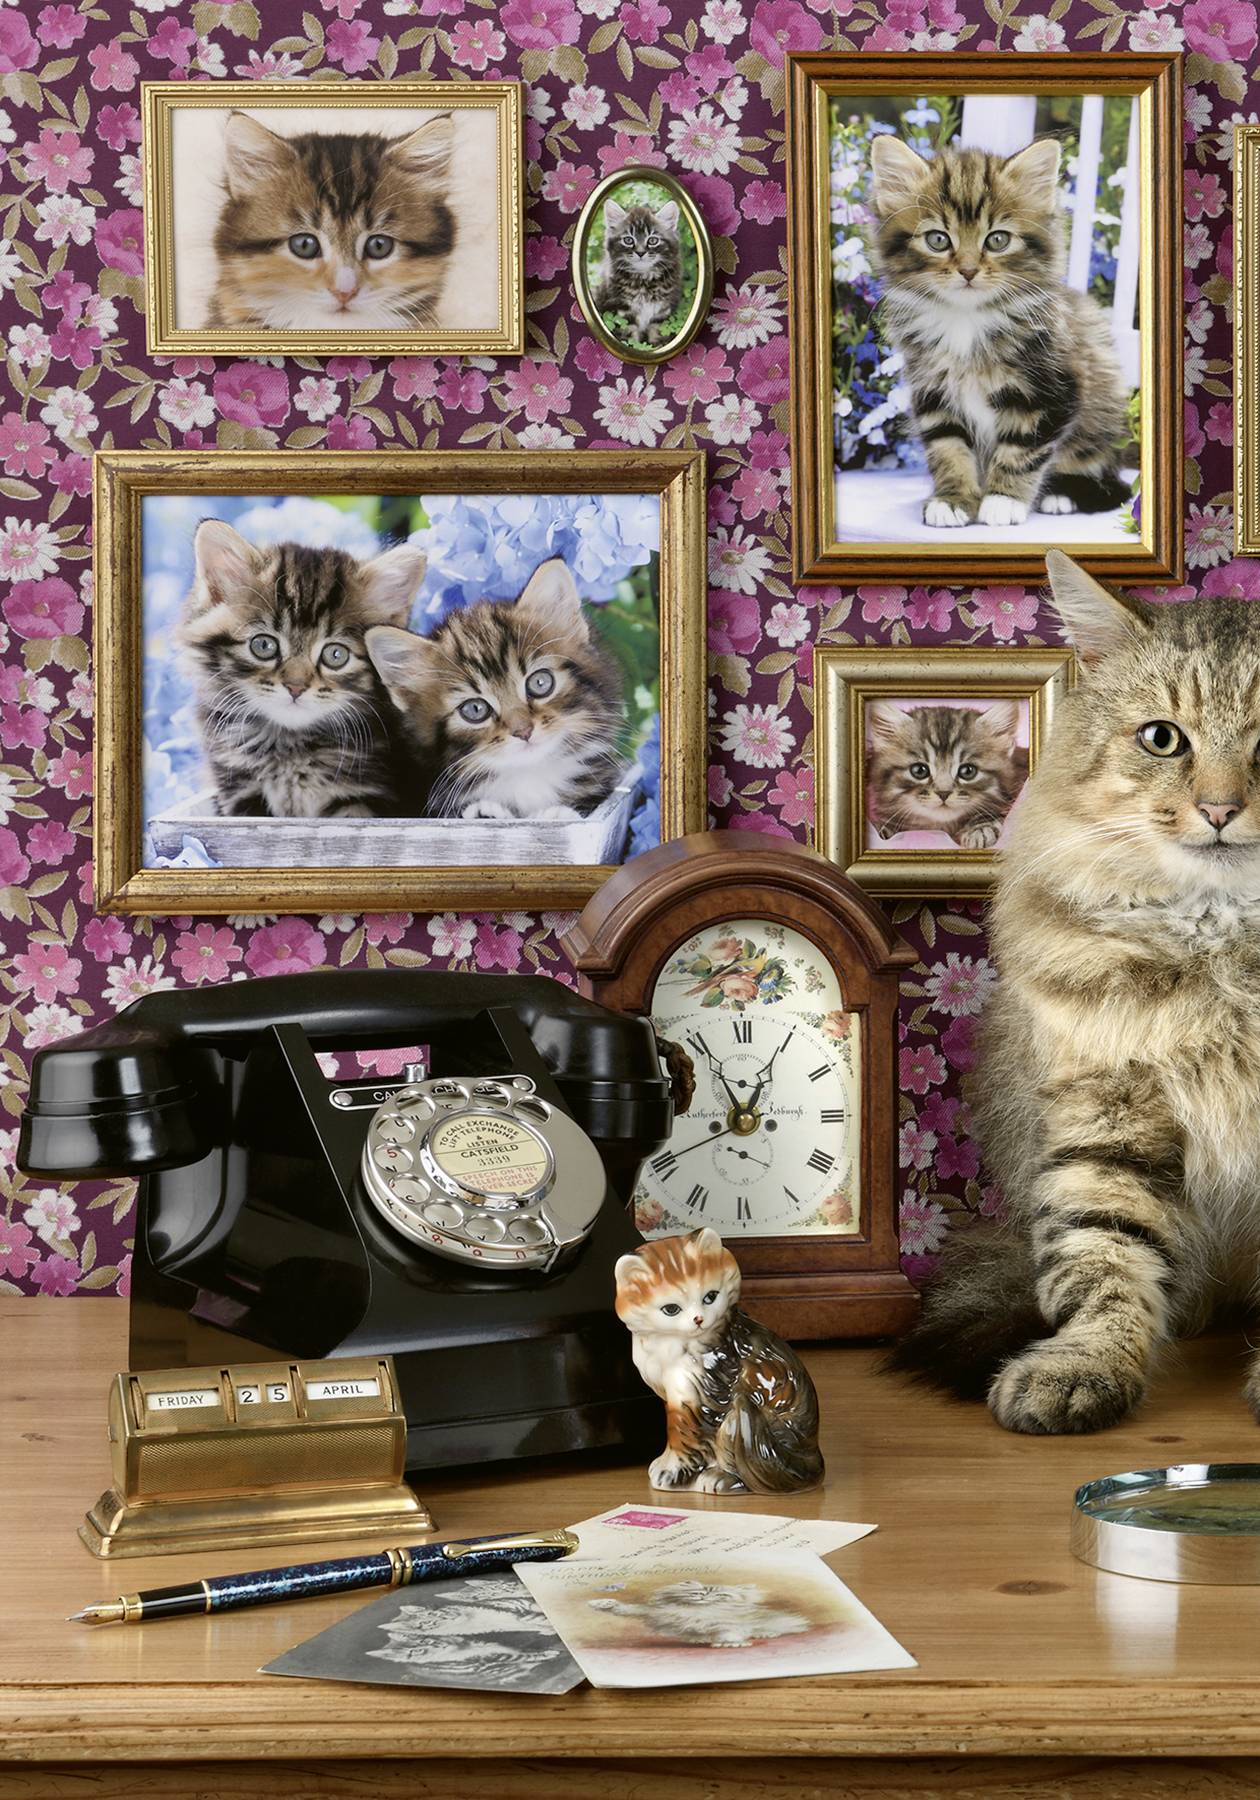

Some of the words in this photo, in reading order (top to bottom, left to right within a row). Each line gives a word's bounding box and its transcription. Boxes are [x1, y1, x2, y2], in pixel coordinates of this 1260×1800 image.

[440, 1136, 449, 1148] TO
[446, 1124, 465, 1136] CALL
[466, 1120, 520, 1136] EXCHANGE
[449, 1134, 461, 1148] LIFT
[460, 1127, 516, 1140] TELEPHONE
[466, 1139, 498, 1148] LISTEN
[460, 1144, 519, 1158] CATSFIELD
[462, 1171, 498, 1182] SPEECH
[500, 1168, 514, 1176] ON
[470, 1174, 522, 1186] TELEPHONE
[158, 1394, 205, 1406] FRIDAY
[240, 1390, 254, 1403] 2
[273, 1388, 286, 1401] 5
[322, 1384, 364, 1396] APRIL
